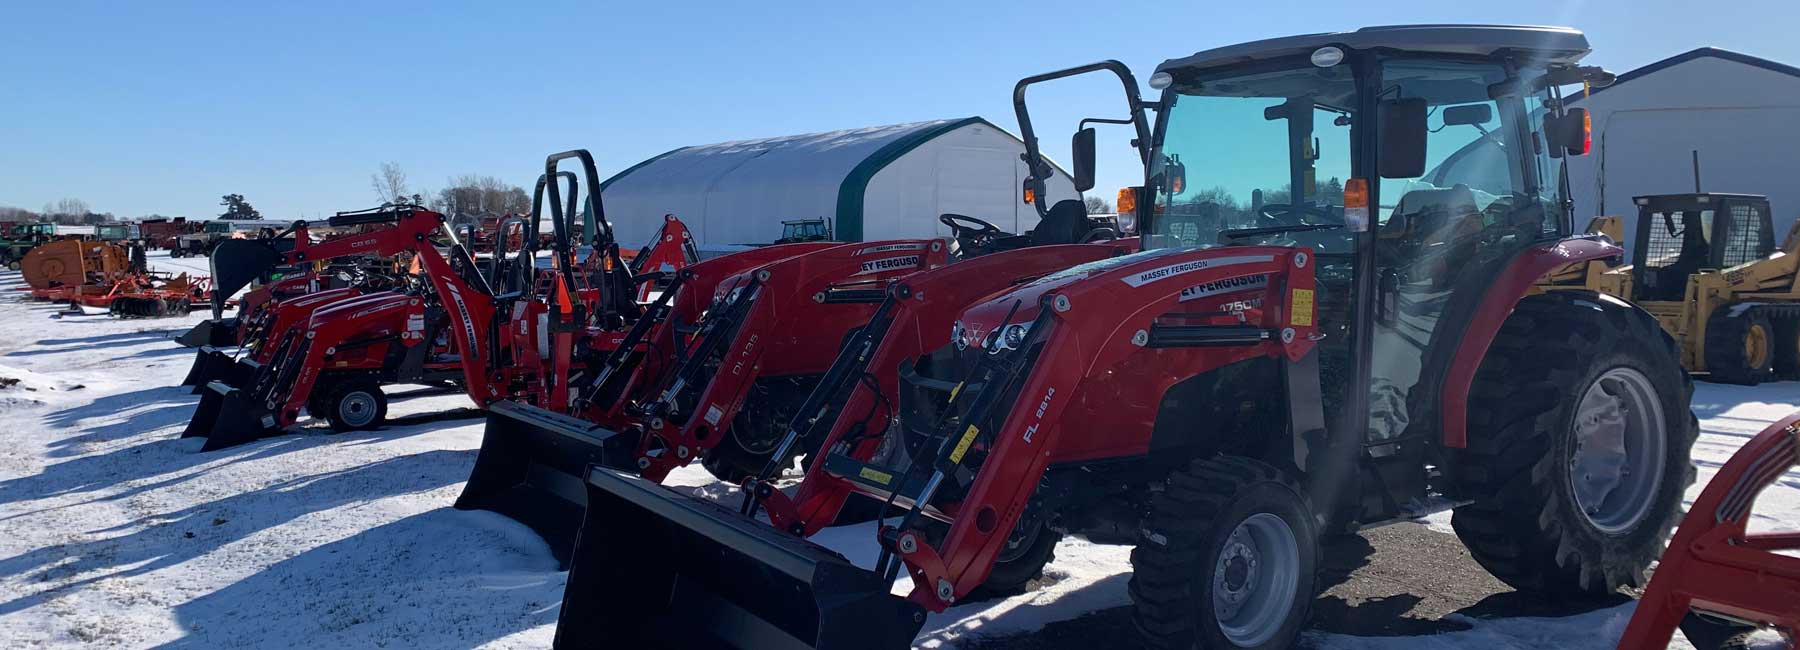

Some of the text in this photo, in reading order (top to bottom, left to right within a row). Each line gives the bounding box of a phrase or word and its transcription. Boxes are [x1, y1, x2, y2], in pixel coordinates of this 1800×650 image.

[1140, 261, 1208, 282] MASSEY FERGUSON
[1199, 273, 1267, 293] FERGUSON
[457, 299, 470, 324] MASSEY
[732, 334, 759, 376] DL 135
[1023, 387, 1055, 443] FL 2814
